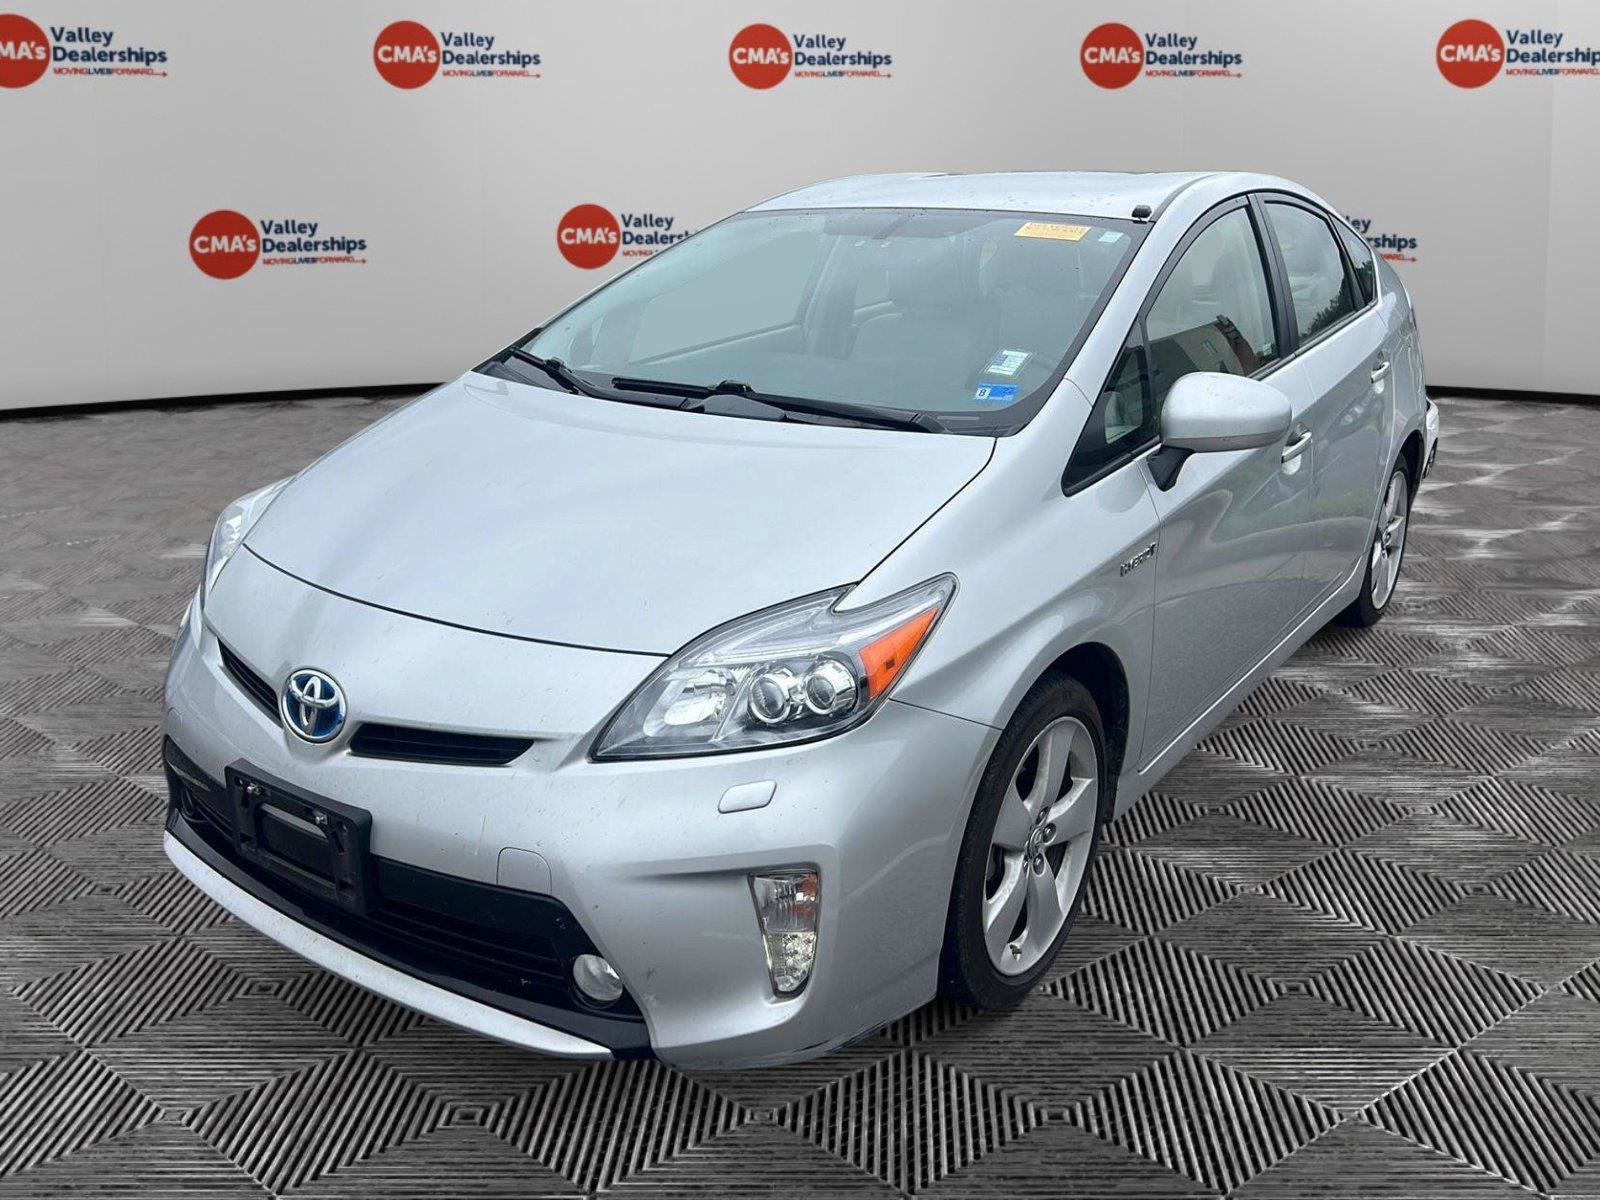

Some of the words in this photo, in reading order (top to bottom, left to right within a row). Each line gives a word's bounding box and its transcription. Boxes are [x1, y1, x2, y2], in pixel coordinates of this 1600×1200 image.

[51, 27, 114, 47] Valley
[441, 32, 494, 50] Valley
[794, 34, 846, 51] Valley
[1145, 33, 1198, 50] Valley
[1506, 29, 1563, 47] Valley
[0, 41, 47, 60] MA's
[53, 46, 168, 66] Dealerships
[377, 45, 437, 63] CMA's
[442, 50, 541, 68] Dealerships
[733, 47, 789, 65] CMA's
[1084, 46, 1140, 64] CMA's
[1146, 51, 1242, 67] Dealerships
[1440, 44, 1500, 62] CMA's
[1506, 48, 1600, 66] Dealership
[794, 52, 892, 68] Dealerships
[260, 219, 318, 237] Valley
[621, 214, 674, 230] Valley
[193, 235, 257, 253] CMA's
[262, 236, 367, 254] Dealerships
[561, 227, 617, 245] CMA's
